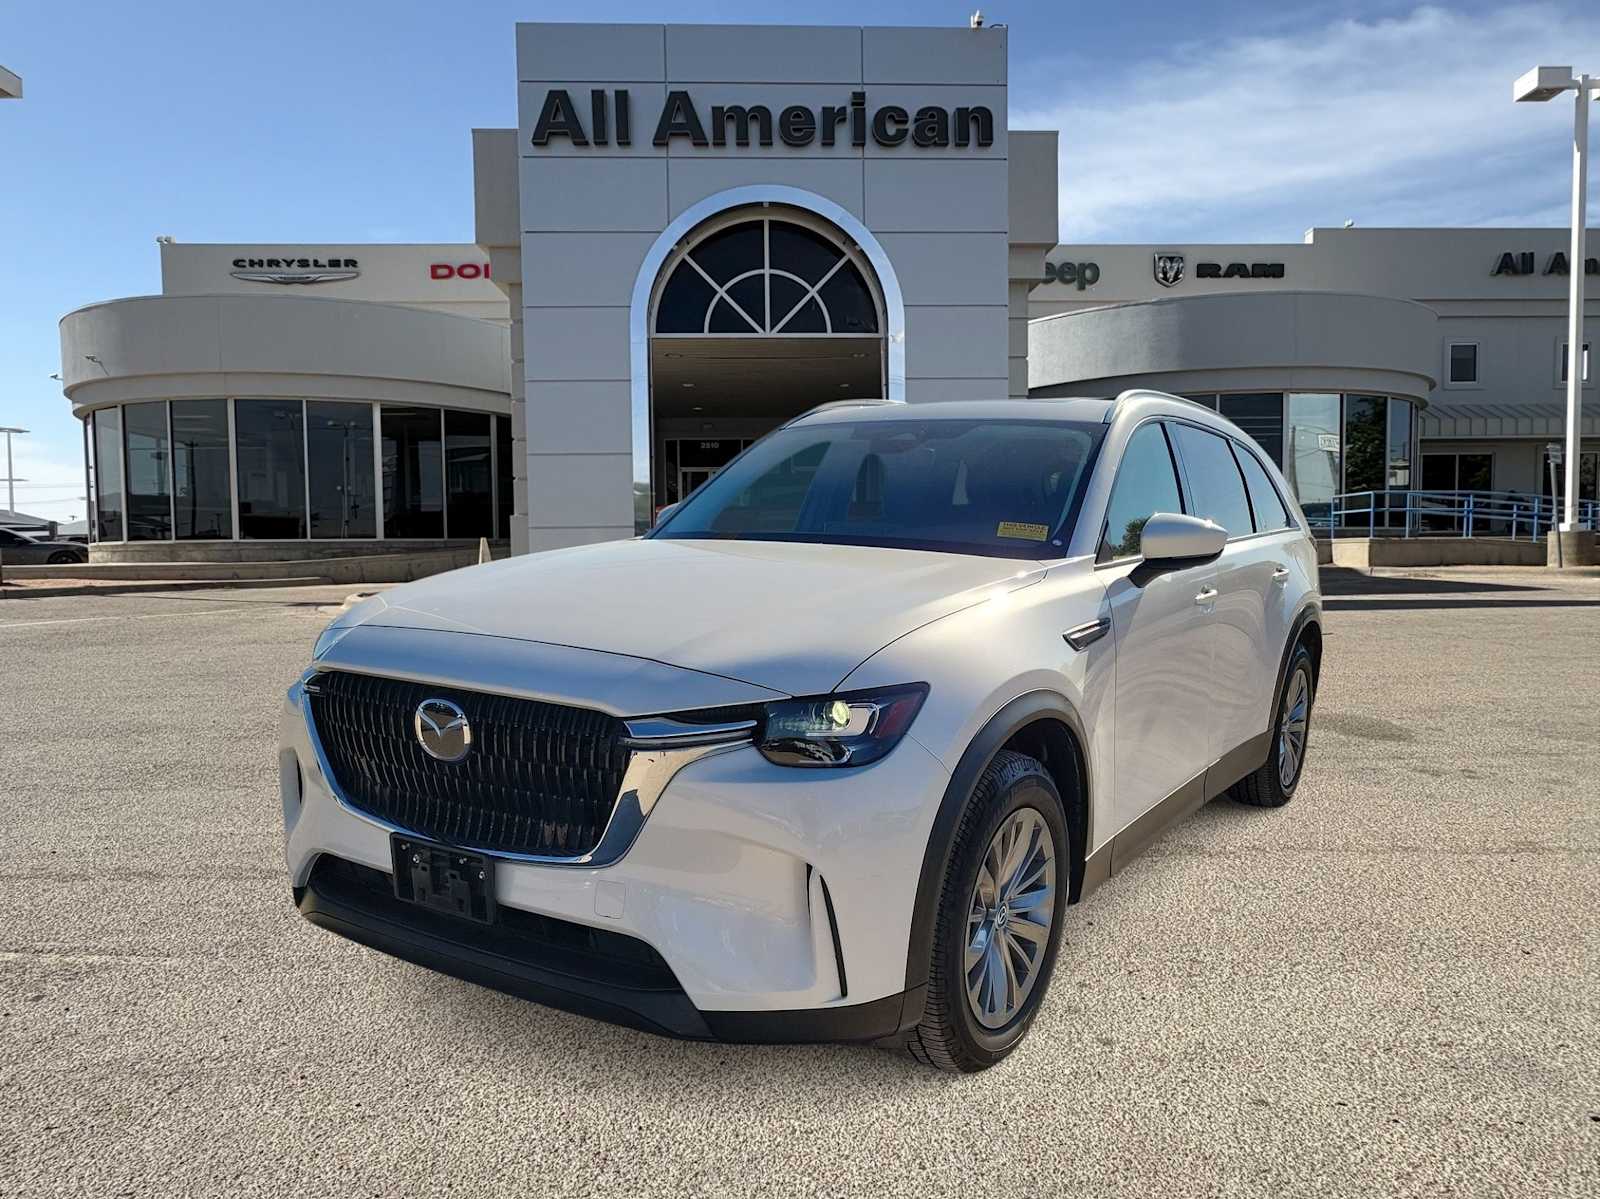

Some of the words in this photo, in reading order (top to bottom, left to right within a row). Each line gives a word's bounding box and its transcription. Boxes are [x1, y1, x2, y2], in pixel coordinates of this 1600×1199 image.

[531, 89, 632, 147] All
[652, 90, 994, 147] American
[232, 258, 359, 268] CHRYSLER
[430, 263, 490, 280] DO
[1196, 263, 1285, 278] RAM
[1490, 252, 1535, 276] All
